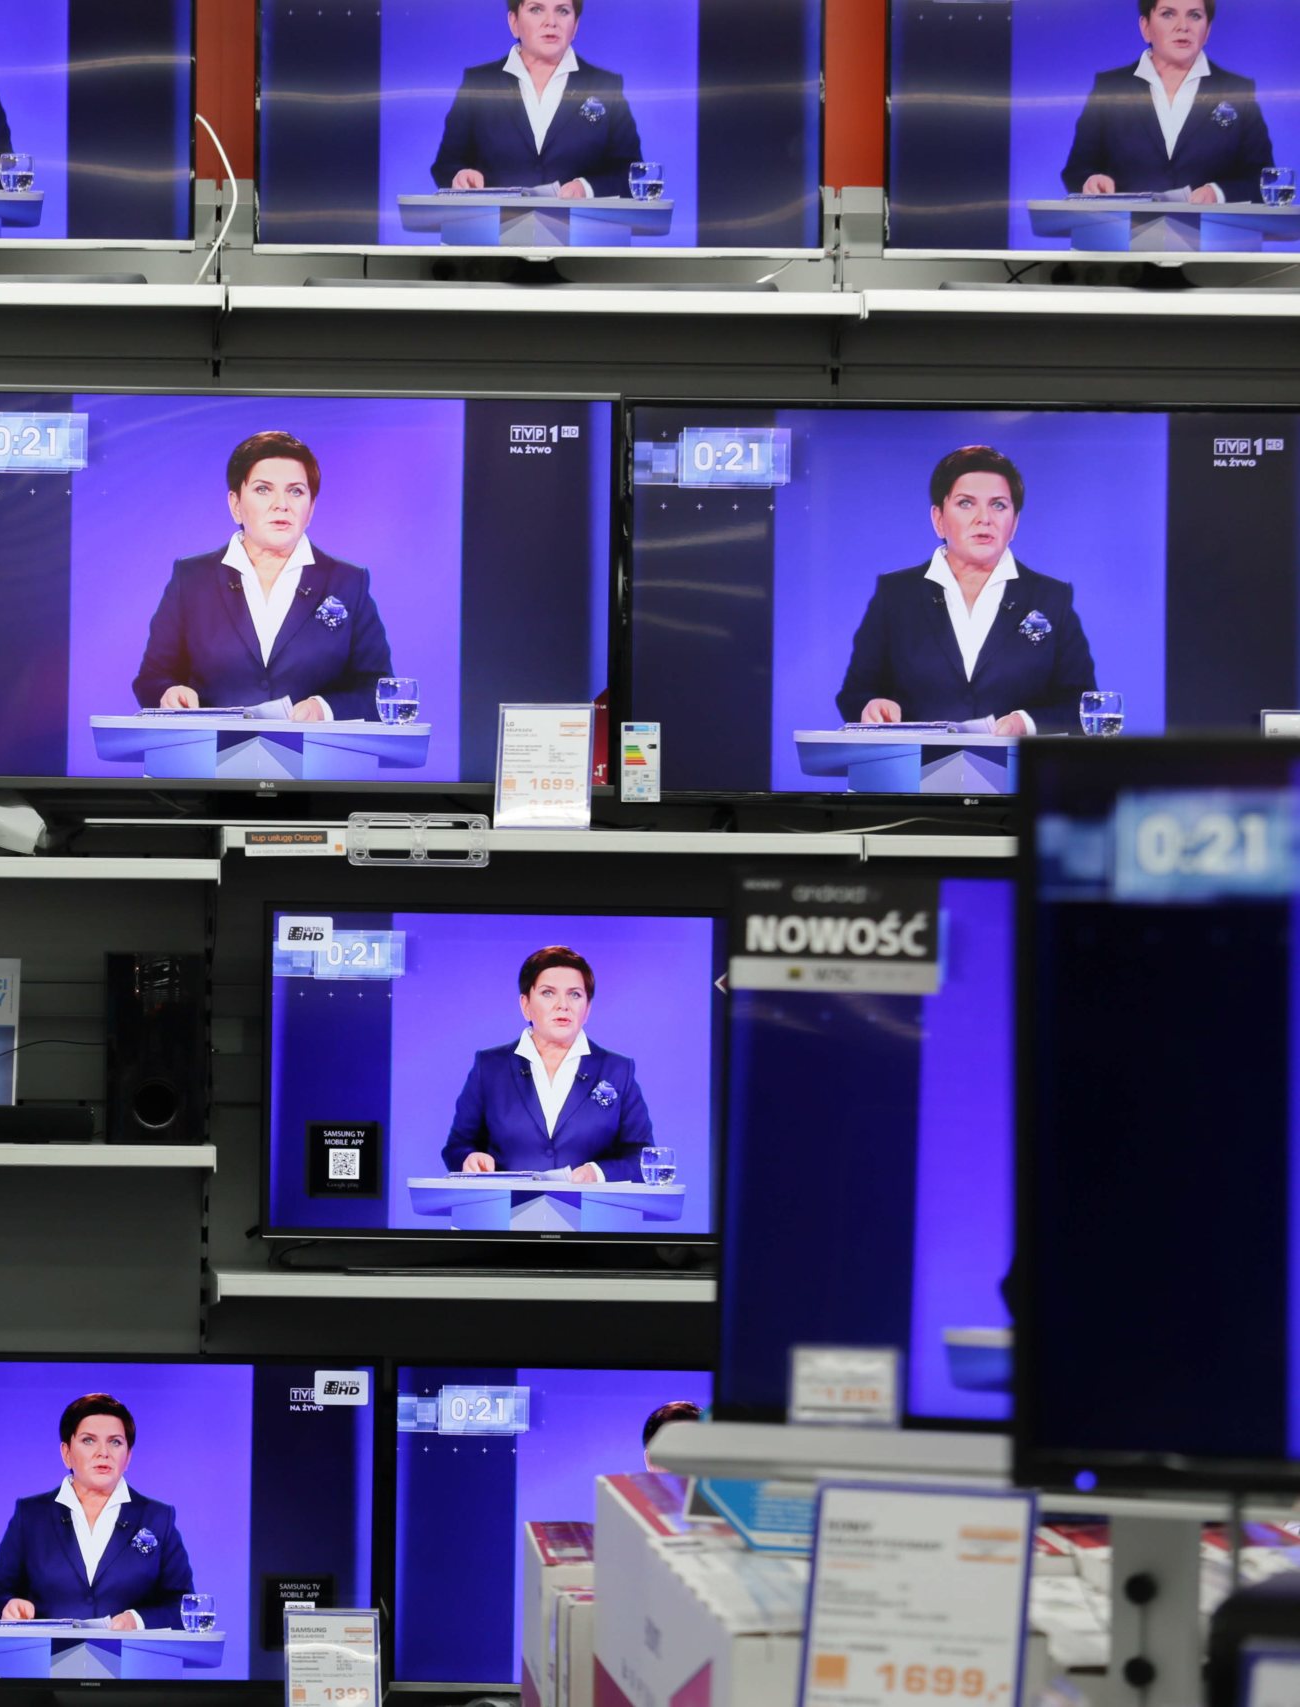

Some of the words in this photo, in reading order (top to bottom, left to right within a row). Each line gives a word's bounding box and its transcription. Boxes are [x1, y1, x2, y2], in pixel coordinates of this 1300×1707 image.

[511, 426, 545, 441] TVP
[550, 425, 558, 442] 1
[561, 426, 579, 438] HD
[510, 446, 523, 454] NA
[525, 444, 552, 454] ŻYWO
[1215, 439, 1250, 455] TVP
[1254, 438, 1263, 455] 1
[1265, 439, 1284, 450] HD
[694, 442, 759, 471] 0:21
[1214, 459, 1227, 467] NA
[1229, 457, 1256, 467] ŻYWO
[302, 932, 324, 941] HD
[746, 911, 928, 957] NOWOŚĆ
[327, 942, 380, 966] 0:21
[337, 1387, 360, 1395] HD
[302, 1403, 324, 1411] ŻYWO
[451, 1397, 504, 1420] 0:21
